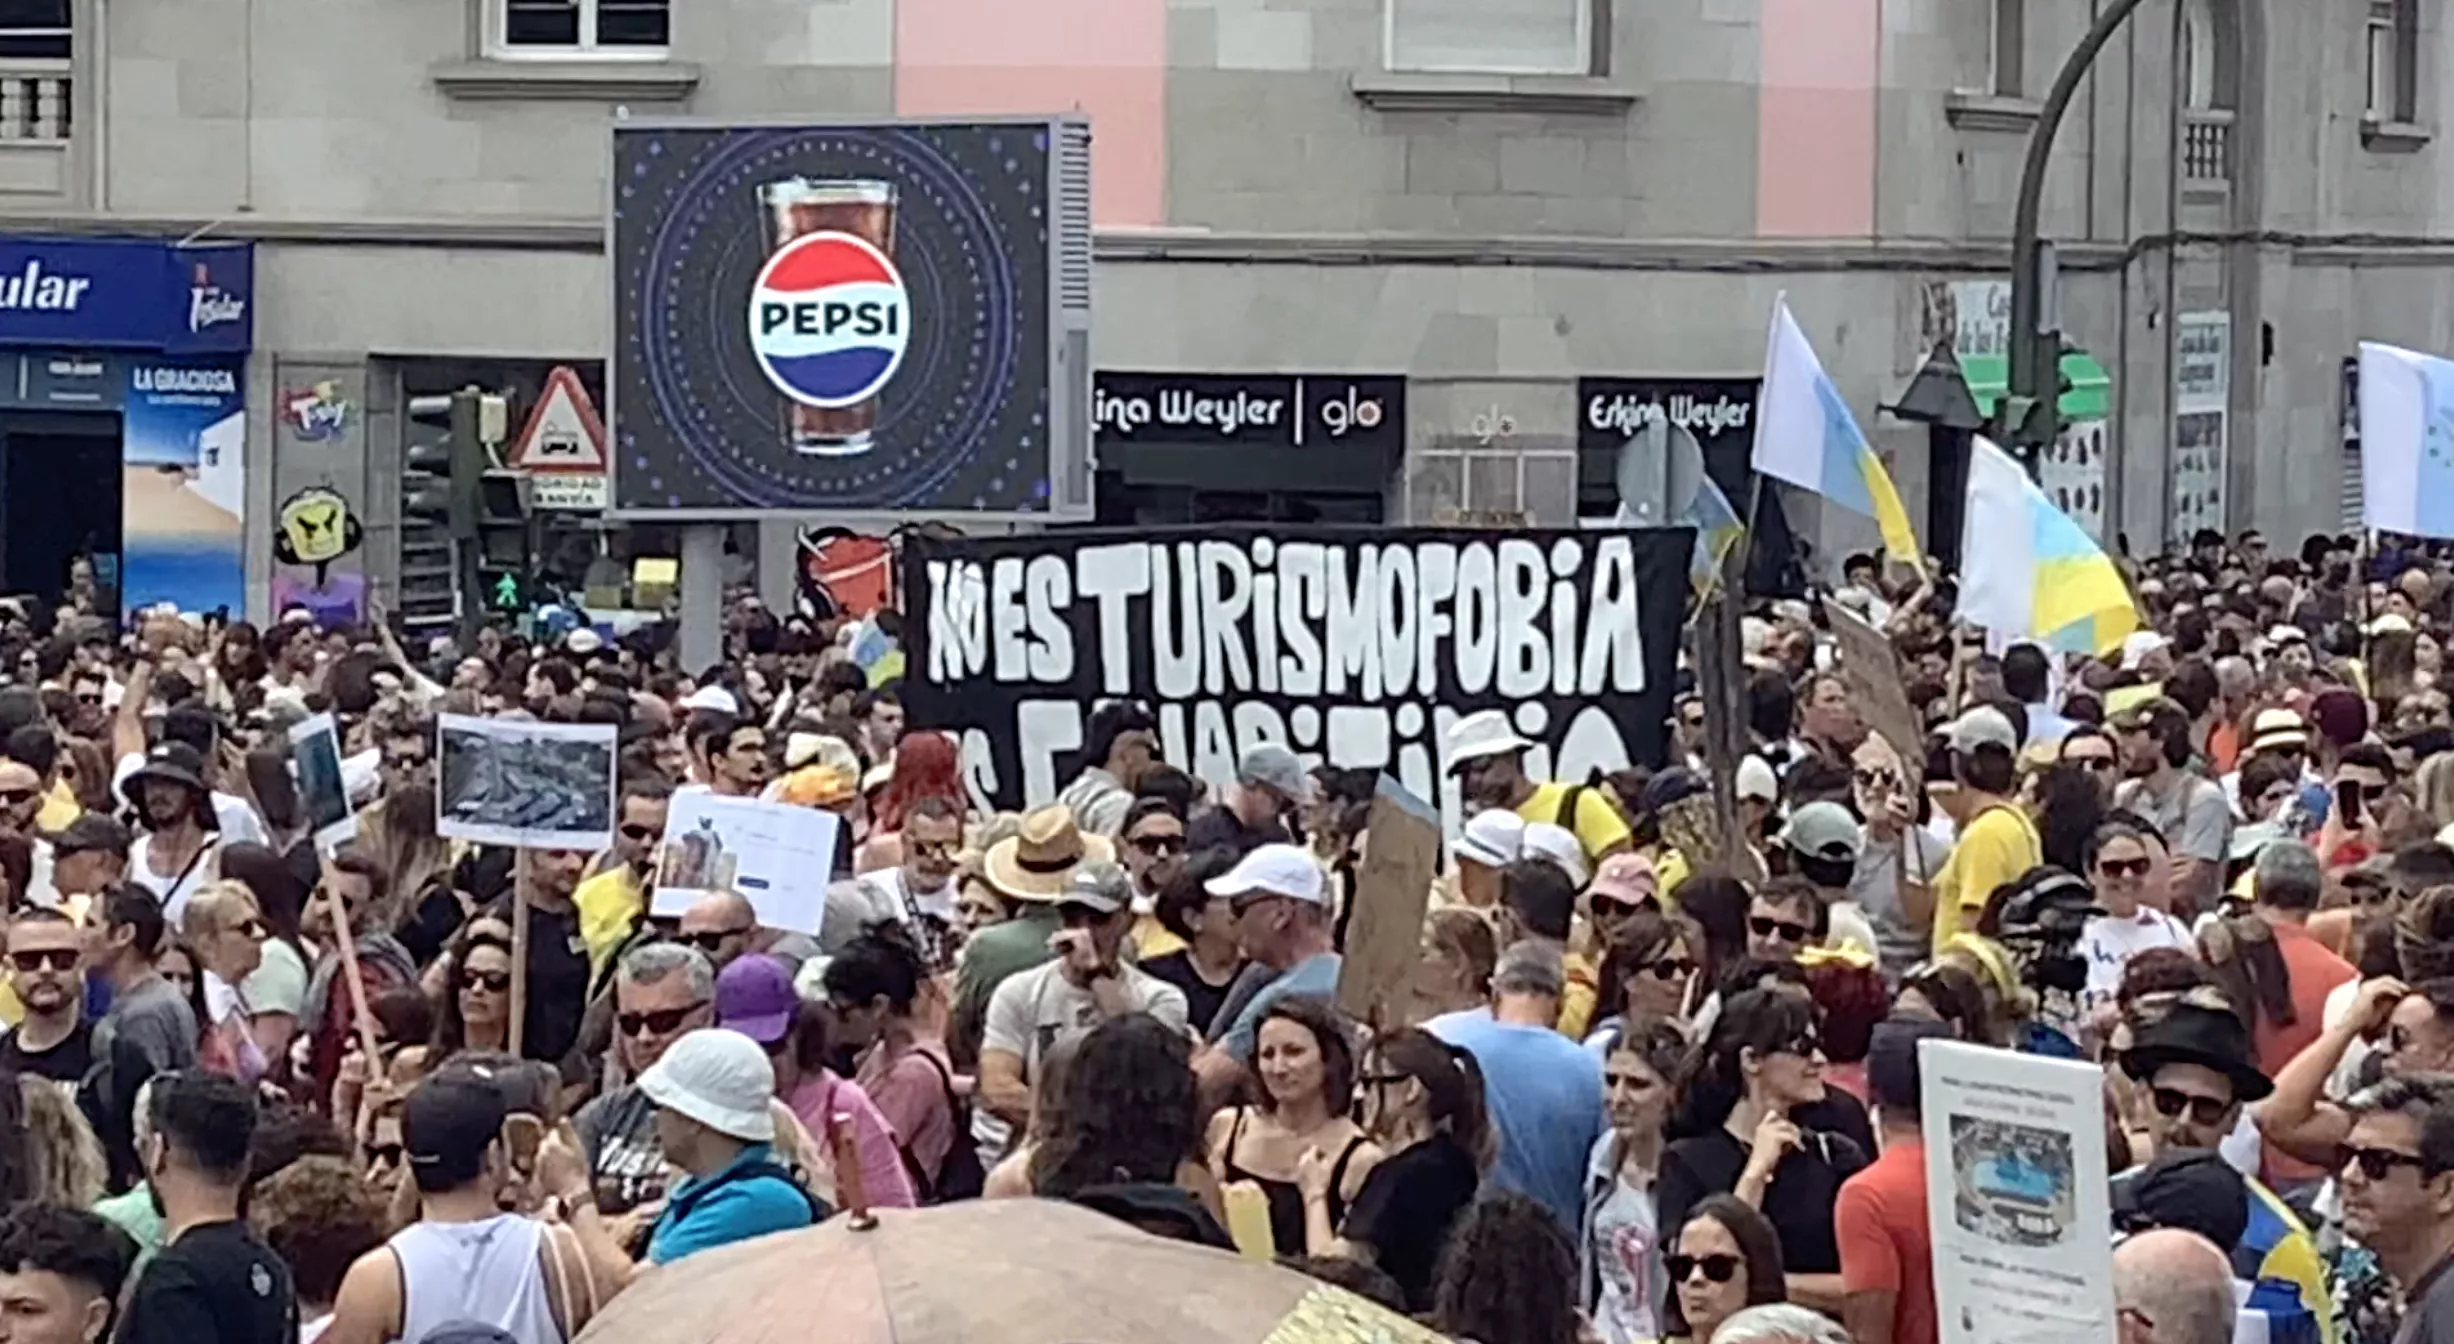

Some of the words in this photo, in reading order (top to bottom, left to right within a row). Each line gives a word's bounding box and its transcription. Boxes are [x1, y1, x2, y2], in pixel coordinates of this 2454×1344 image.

[761, 302, 898, 336] PEPSI
[1159, 389, 1283, 434] Weyler
[1322, 385, 1382, 436] glo
[927, 558, 987, 683] NO
[992, 554, 1075, 683] ES
